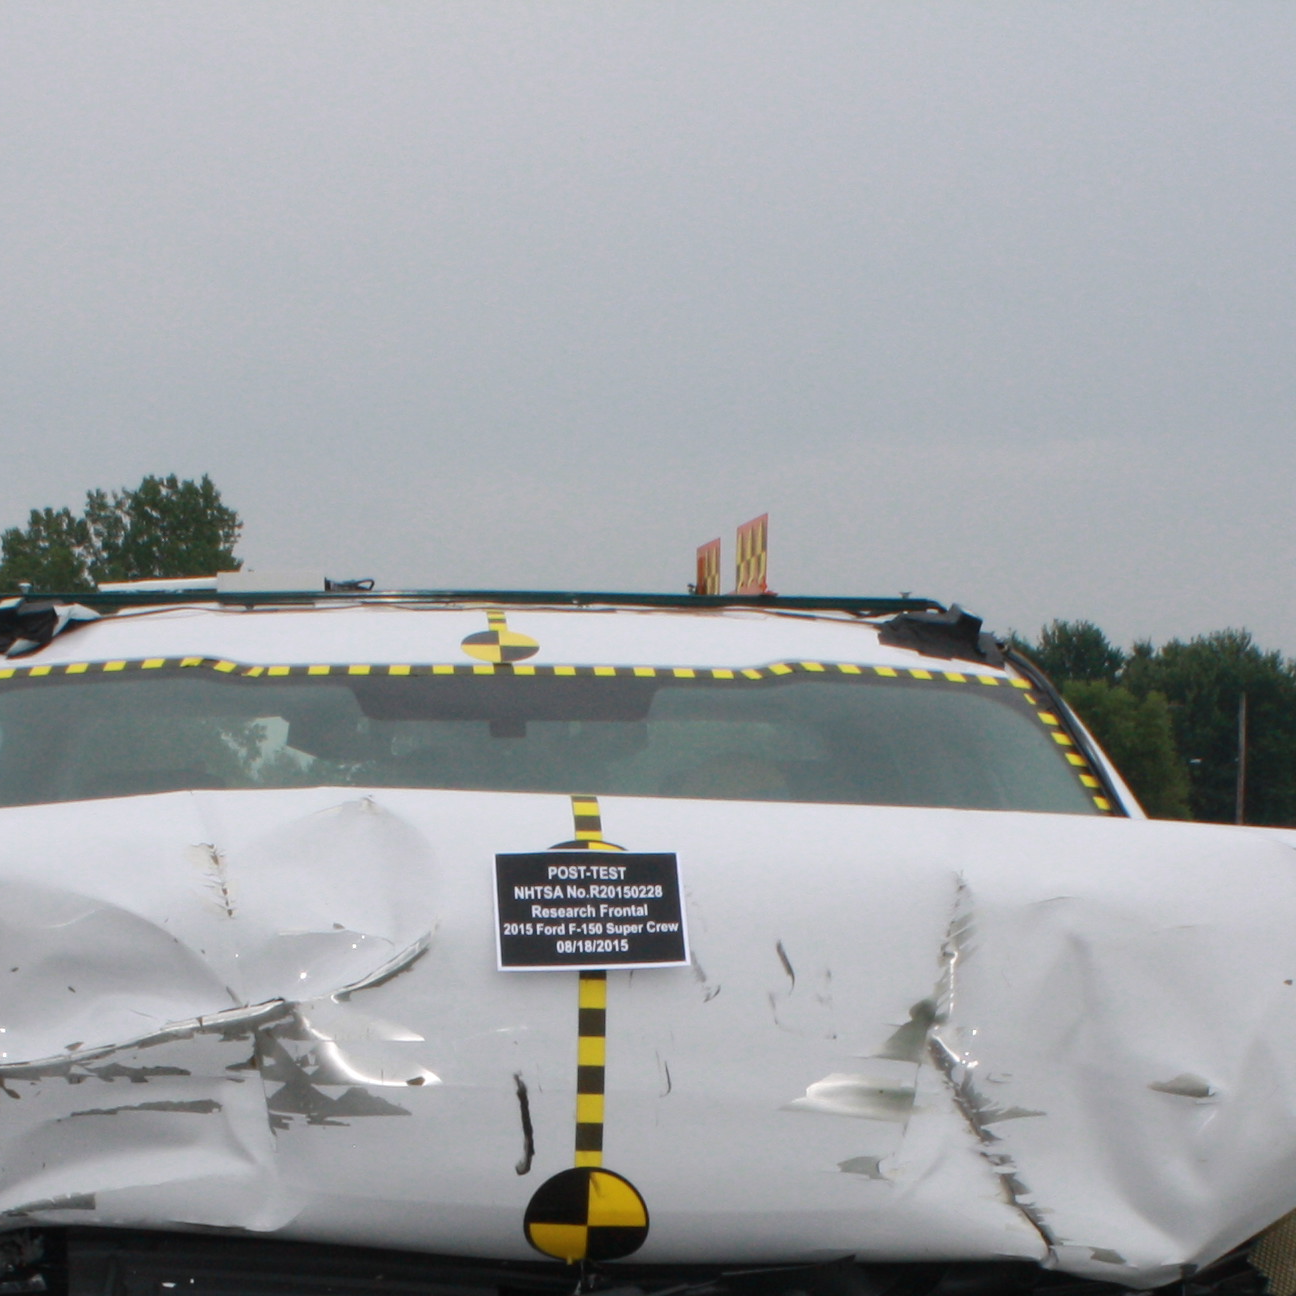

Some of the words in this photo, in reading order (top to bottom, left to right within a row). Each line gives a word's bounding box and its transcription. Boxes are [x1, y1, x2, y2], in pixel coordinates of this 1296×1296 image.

[548, 866, 626, 880] POST-TEST
[514, 886, 563, 899] NHTSA
[567, 885, 663, 898] No.R20150228
[532, 905, 595, 917] Research
[600, 904, 648, 917] Frontal
[504, 923, 533, 935] 2015
[536, 923, 565, 935] Ford
[569, 923, 602, 935] F-150
[606, 922, 643, 936] Super
[646, 920, 678, 932] Crew
[557, 939, 629, 953] 08/18/2015
